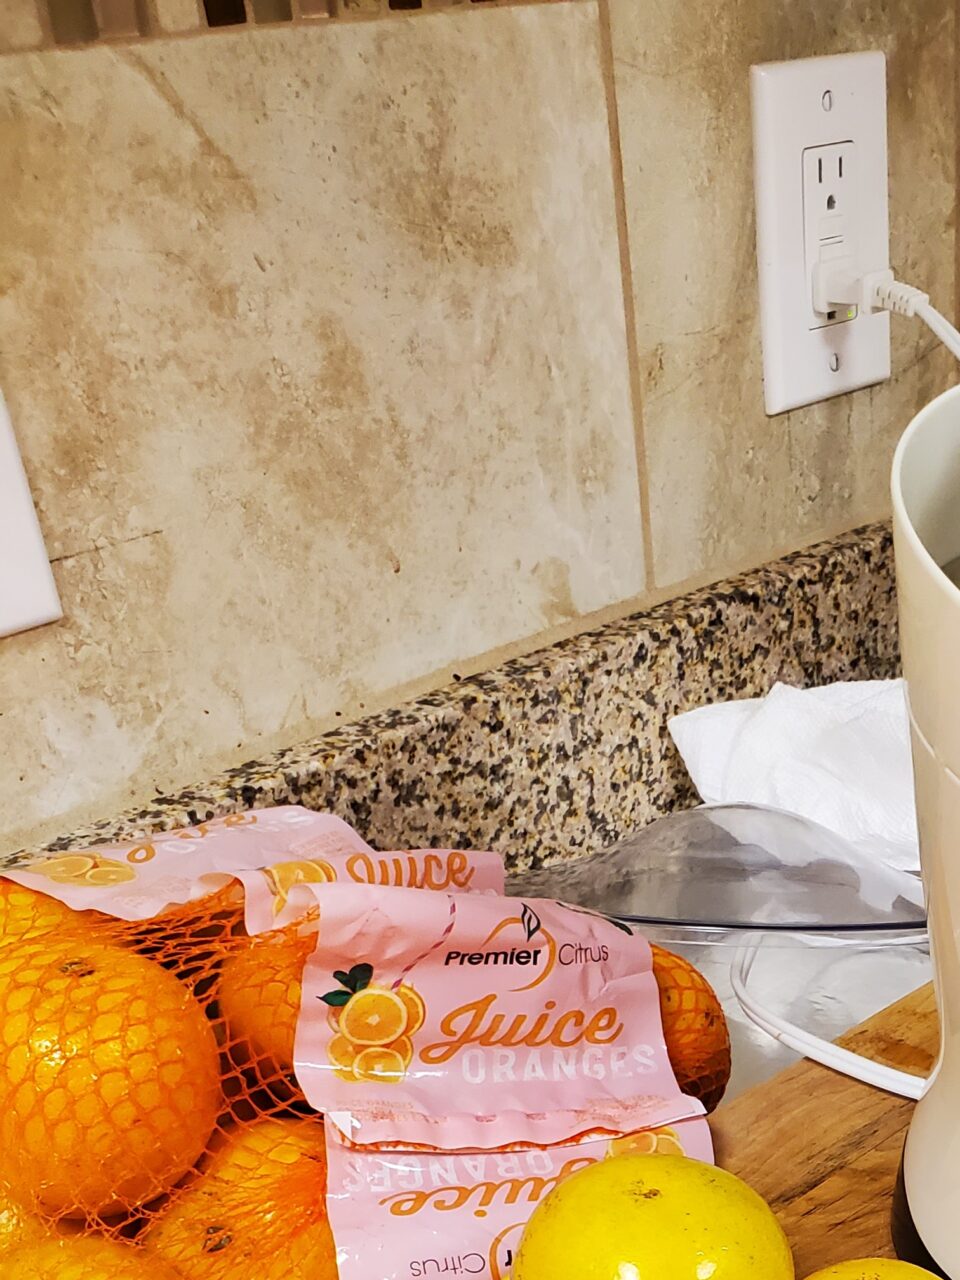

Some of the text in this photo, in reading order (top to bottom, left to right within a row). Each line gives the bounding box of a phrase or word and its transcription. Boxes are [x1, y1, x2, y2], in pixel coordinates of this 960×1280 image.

[444, 943, 609, 967] Premier Citrus
[418, 993, 625, 1065] Juice
[461, 1045, 659, 1085] ORANGES
[409, 1252, 486, 1277] Citrus
